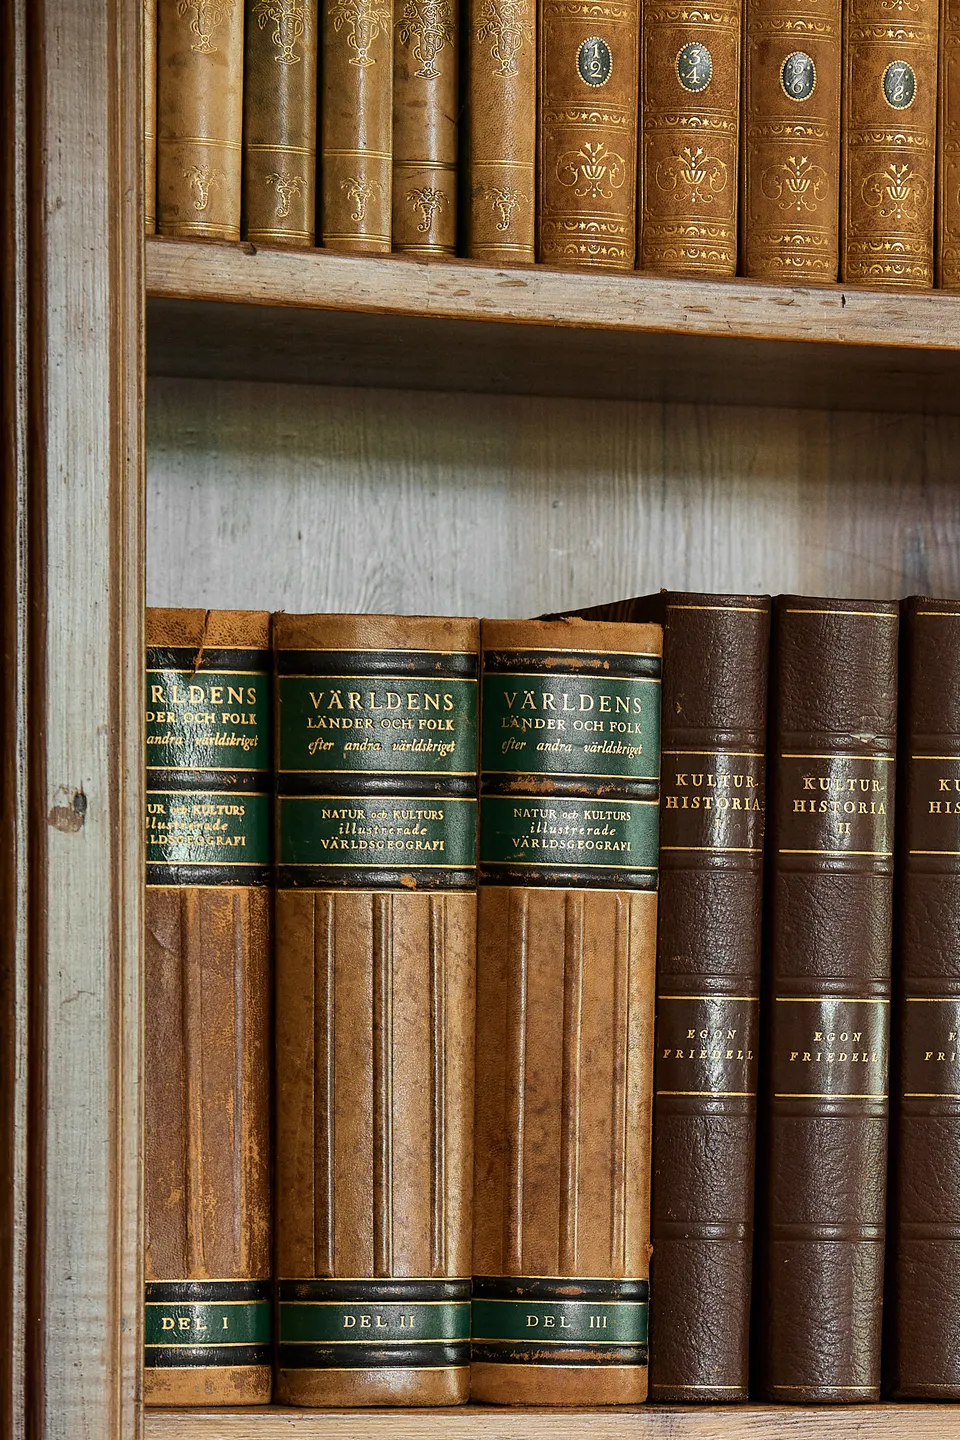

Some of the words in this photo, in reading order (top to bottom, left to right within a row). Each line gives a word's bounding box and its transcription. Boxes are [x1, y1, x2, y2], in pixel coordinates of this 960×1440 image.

[591, 43, 600, 59] 1
[689, 49, 701, 65] 3
[590, 60, 602, 78] 2
[792, 59, 807, 75] 5
[686, 67, 700, 84] 4
[893, 68, 906, 85] 7
[791, 77, 804, 94] 6
[151, 685, 257, 705] RLDENS
[309, 690, 455, 711] VÄRLDENS
[503, 690, 642, 714] VÄRLDENS
[183, 712, 216, 724] OCH
[221, 712, 257, 725] FOLK
[306, 715, 375, 729] LÄNDER
[380, 718, 412, 730] OCH
[418, 719, 455, 731] FOLK
[501, 715, 567, 730] LÄNDER
[573, 719, 604, 732] OCH
[609, 721, 642, 734] FOLK
[146, 731, 184, 745] andra
[195, 732, 259, 751] världskriget
[308, 737, 335, 756] efter
[344, 738, 382, 752] andra
[391, 738, 457, 757] världskriget
[501, 736, 527, 754] efter
[536, 738, 573, 753] andra
[583, 740, 643, 759] världskriget
[193, 804, 245, 816] KULTURS
[665, 796, 761, 811] HISTORIA
[792, 799, 887, 815] HISTORIA
[321, 809, 366, 819] NATUR
[393, 810, 444, 820] KULTURS
[513, 808, 557, 818] NATUR
[584, 810, 631, 821] KULTURS
[145, 816, 229, 831] llustrerade
[339, 822, 428, 836] illustrerade
[530, 821, 617, 836] illustrerade
[837, 822, 851, 834] II
[150, 834, 247, 847] LDSGEOGRAFI
[321, 836, 445, 851] VÄRLDSGEOGRAFI
[512, 835, 632, 852] VÄRLDSGEOGRAFI
[686, 1029, 737, 1040] EGON
[813, 1031, 862, 1042] EGON
[662, 1049, 754, 1061] FRIEDELL
[789, 1051, 879, 1063] FRIEDELL
[161, 1317, 208, 1330] DEL
[222, 1316, 229, 1329] I
[343, 1315, 388, 1328] DEL
[400, 1315, 415, 1328] II
[526, 1315, 571, 1328] DEL
[589, 1315, 608, 1328] III
